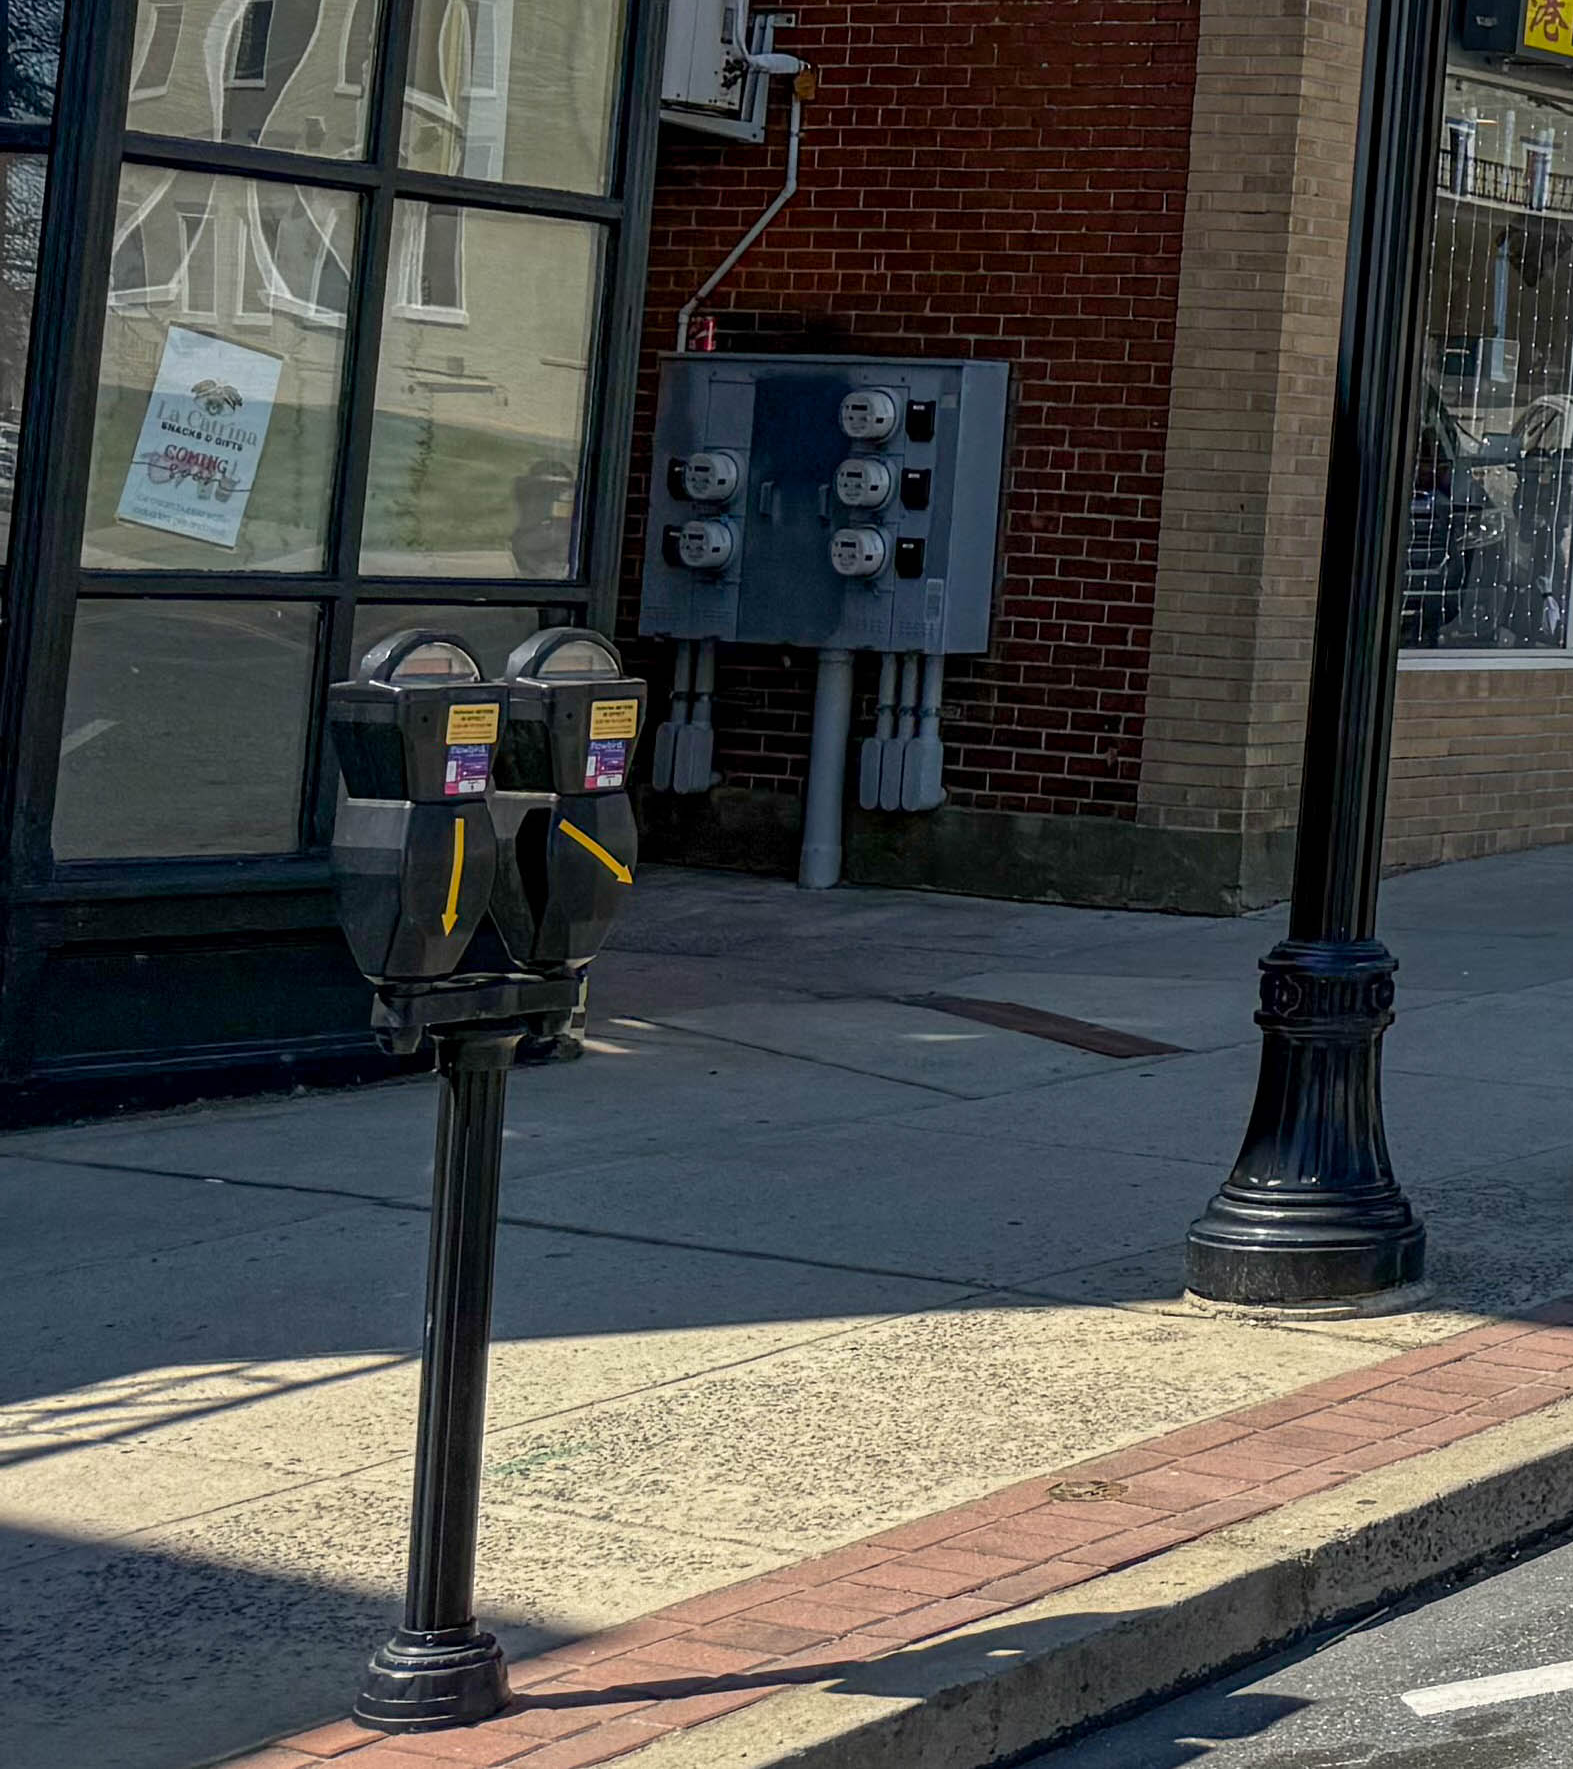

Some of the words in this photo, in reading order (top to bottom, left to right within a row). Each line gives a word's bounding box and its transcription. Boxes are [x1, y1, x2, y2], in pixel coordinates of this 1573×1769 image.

[157, 400, 181, 423] La
[161, 421, 203, 440] SNACKS
[215, 436, 244, 452] GIFTS
[164, 444, 229, 477] COMING
